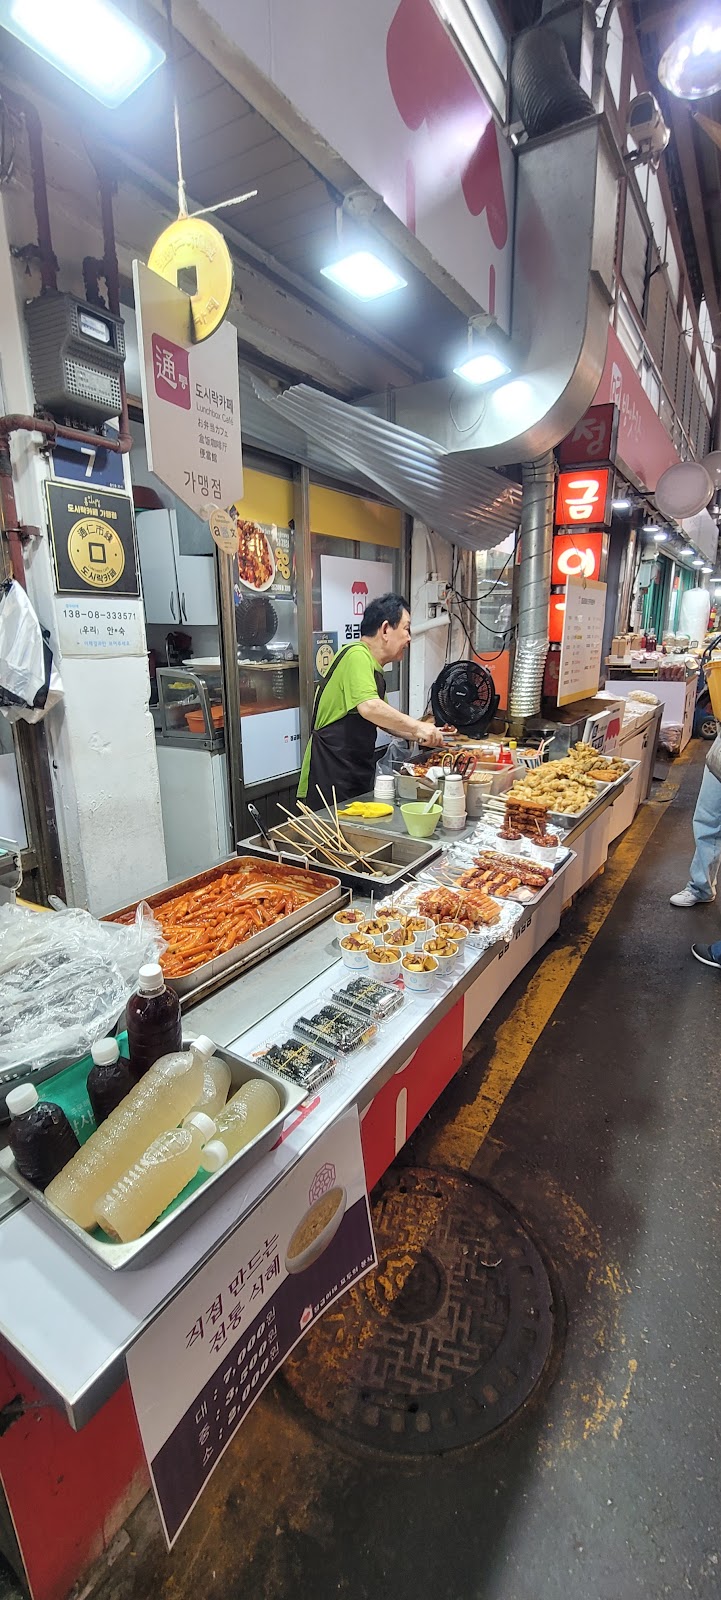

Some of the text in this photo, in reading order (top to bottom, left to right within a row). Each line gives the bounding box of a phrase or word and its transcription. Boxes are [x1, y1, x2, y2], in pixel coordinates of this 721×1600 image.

[156, 345, 178, 389] 通
[195, 383, 233, 415] 도시락카페
[196, 401, 233, 426] Lunchbox Café
[197, 417, 229, 438] お弁当カフェ
[80, 446, 96, 477] 7
[183, 470, 222, 500] 가맹점
[67, 503, 98, 517] 도시락카페
[81, 565, 117, 583] 도시락카페
[63, 609, 136, 620] 138-08-333571
[79, 625, 99, 636] (우리)
[185, 1233, 279, 1349] 직접 만드는
[209, 1253, 280, 1354] 전통 식혜
[195, 1401, 208, 1424] 대
[223, 1306, 276, 1384] 7,000원
[198, 1422, 210, 1445] 중
[225, 1324, 278, 1406] 3,500원
[202, 1446, 214, 1467] 소
